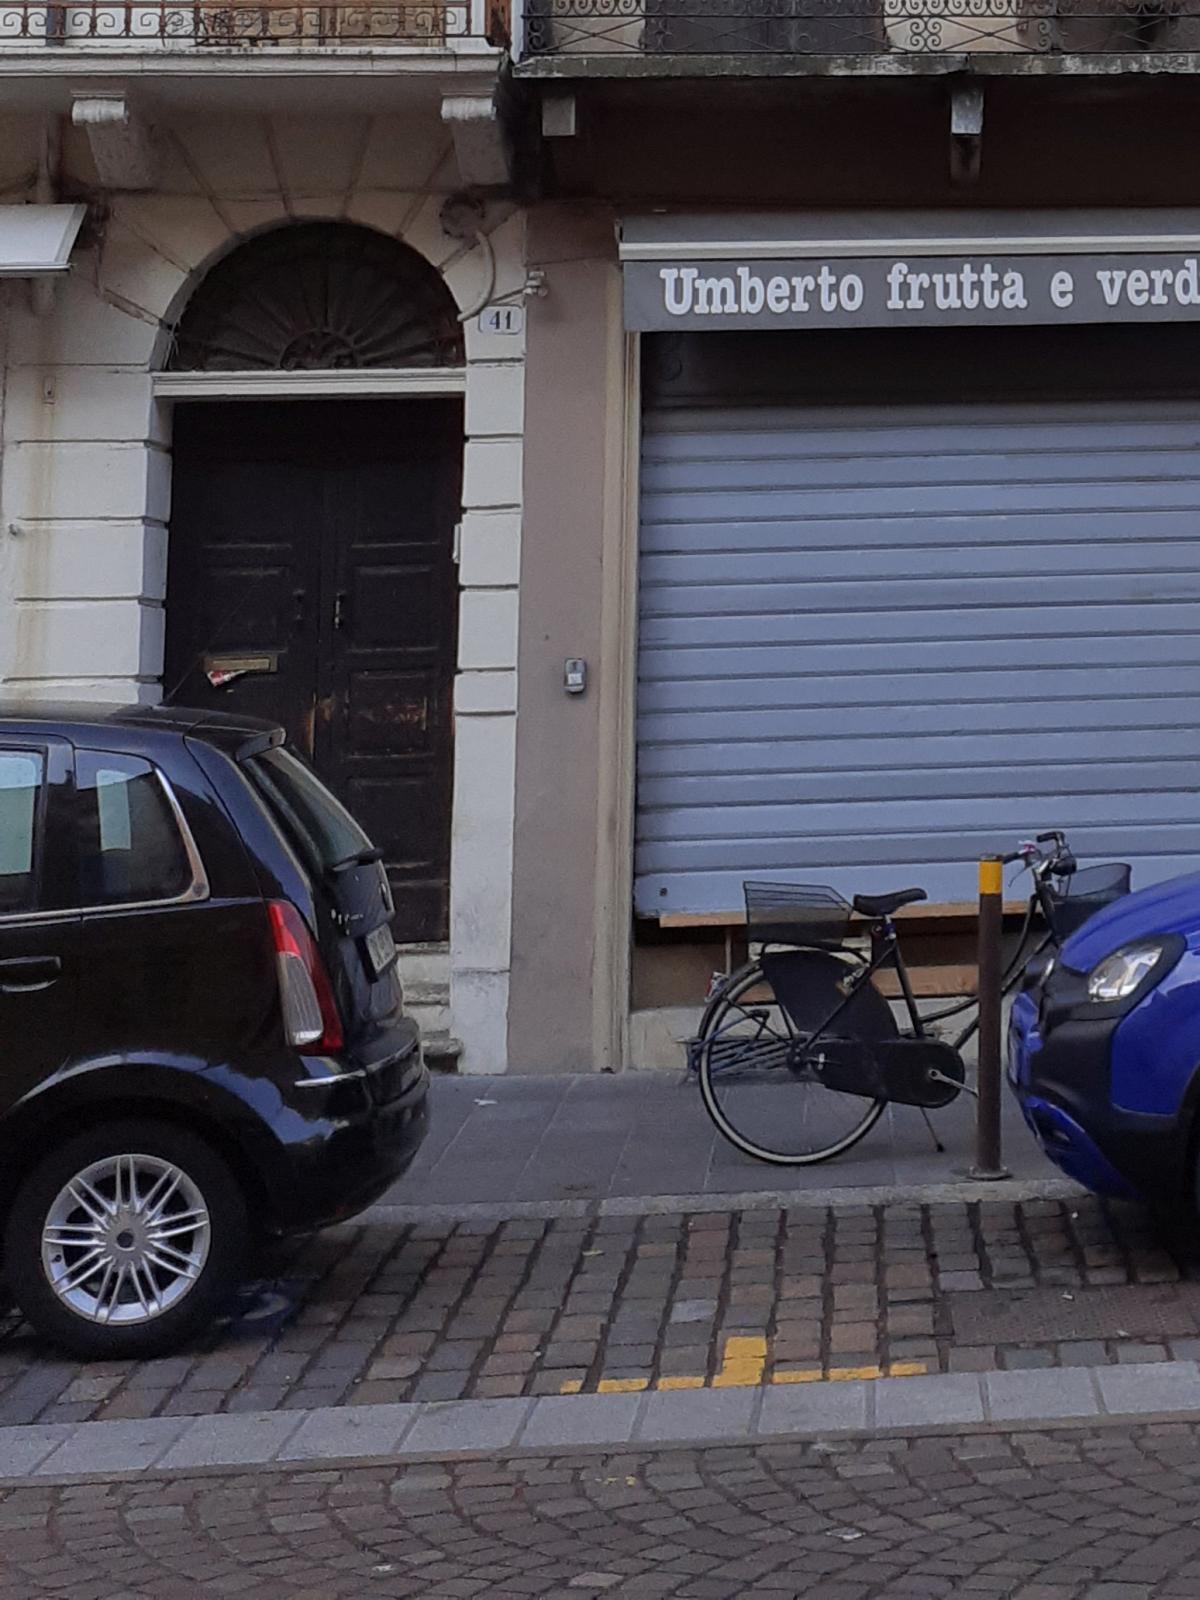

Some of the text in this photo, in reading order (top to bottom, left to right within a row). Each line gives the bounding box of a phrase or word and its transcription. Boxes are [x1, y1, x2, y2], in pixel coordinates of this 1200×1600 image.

[659, 266, 864, 315] Umberto
[885, 261, 1028, 309] frutta
[1050, 270, 1073, 308] e
[489, 310, 511, 330] 41
